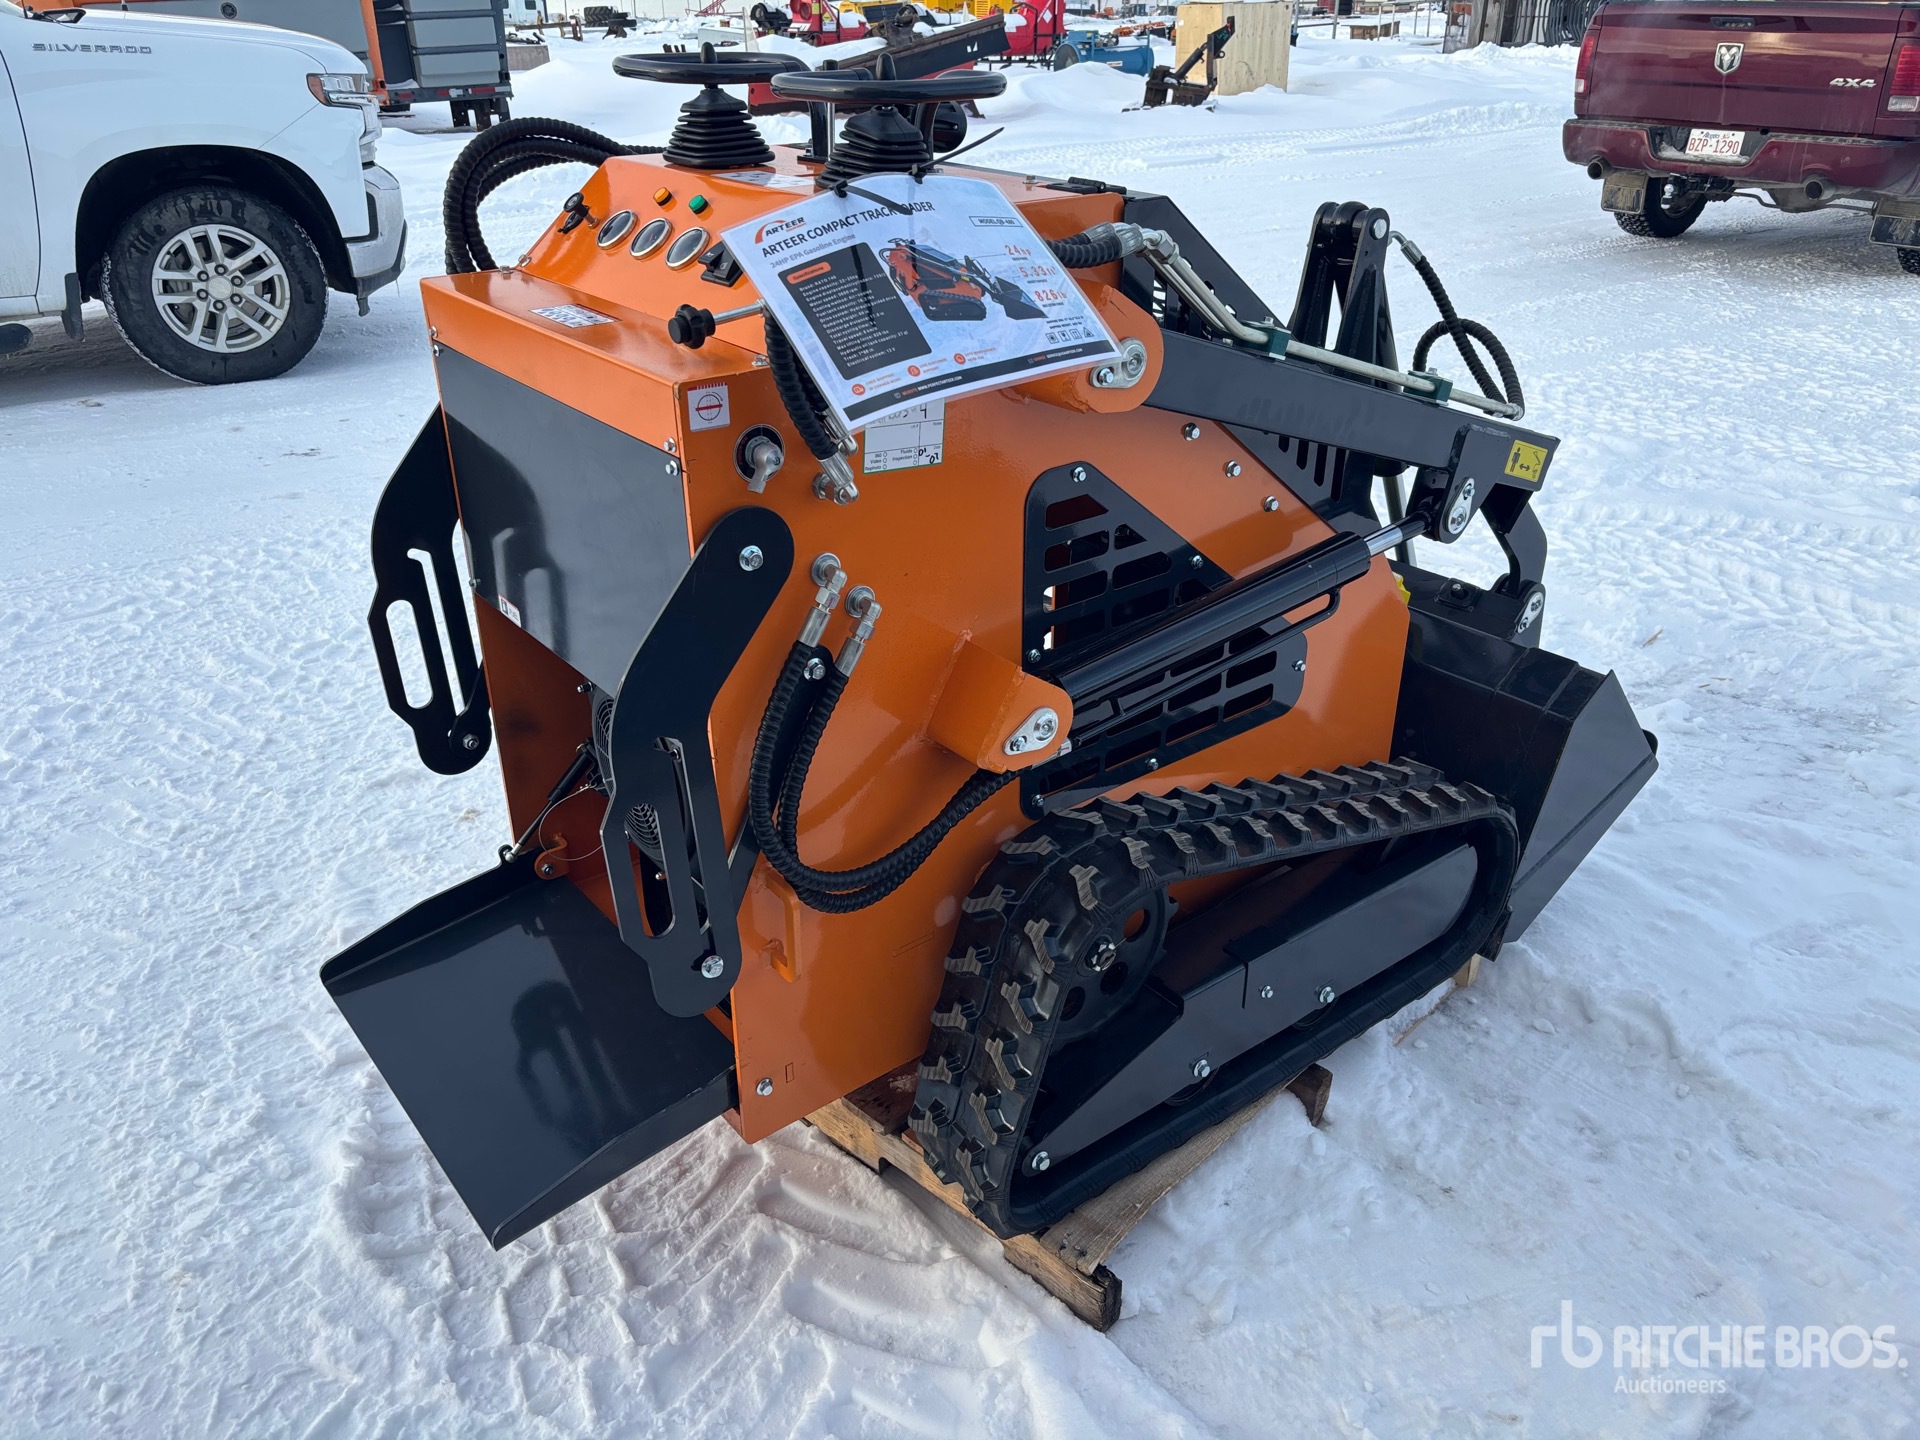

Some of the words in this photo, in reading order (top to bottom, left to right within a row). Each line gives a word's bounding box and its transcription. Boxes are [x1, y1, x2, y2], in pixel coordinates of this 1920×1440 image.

[32, 43, 152, 55] SILVERADO
[1829, 77, 1877, 88] 4X4
[762, 233, 808, 258] ARTEER
[806, 213, 863, 239] COMPACT
[859, 205, 898, 222] TRACK
[765, 217, 806, 237] ARTEER
[770, 257, 789, 269] 24HP
[789, 251, 805, 263] EPA
[804, 240, 833, 257] Gasoline
[832, 233, 857, 249] Engine
